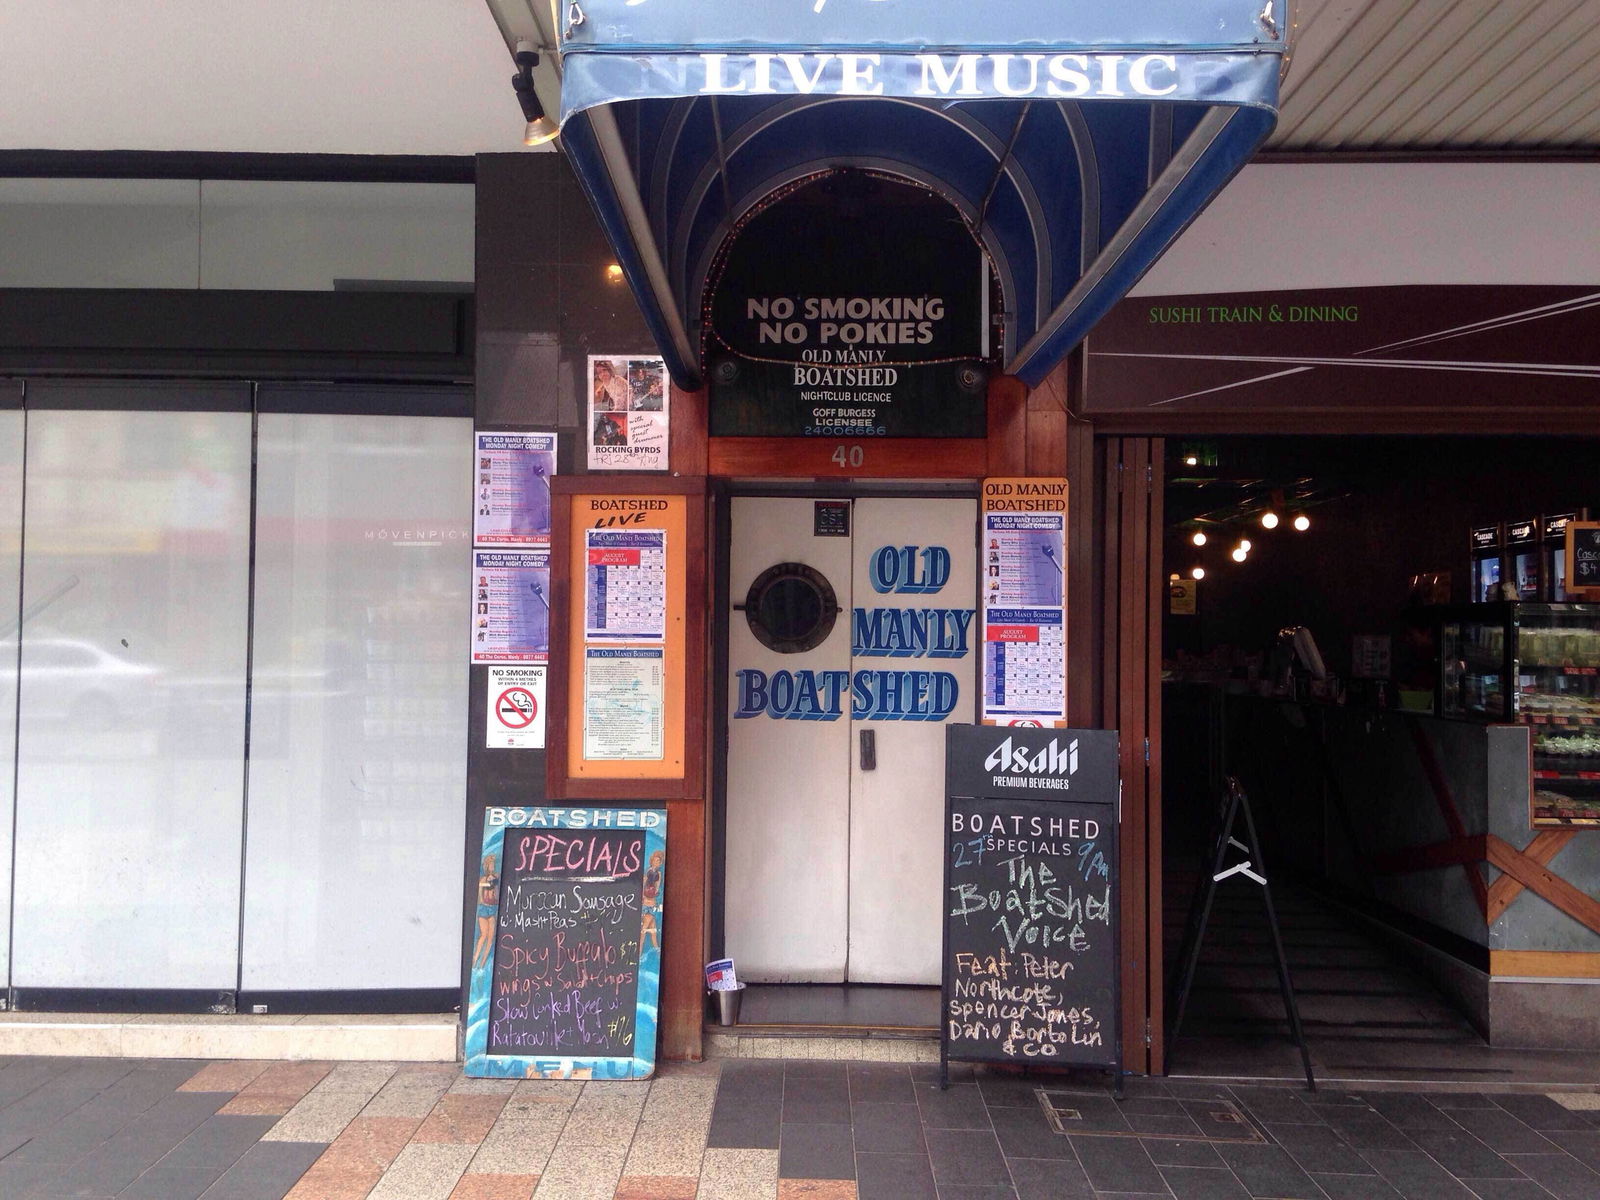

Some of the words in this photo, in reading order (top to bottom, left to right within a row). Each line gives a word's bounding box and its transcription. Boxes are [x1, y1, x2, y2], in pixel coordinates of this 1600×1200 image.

[699, 53, 883, 96] LIVE
[914, 53, 1179, 98] MUSIC
[747, 298, 795, 320] NO
[804, 298, 945, 320] SMOKING
[1149, 307, 1201, 323] SUSHI
[1207, 307, 1262, 322] TRAIN
[1268, 304, 1284, 322] &
[1289, 306, 1358, 322] DINING
[759, 322, 808, 344] NO
[820, 321, 934, 344] POKIES
[802, 350, 831, 363] OLD
[835, 350, 886, 364] MANLY
[793, 367, 898, 386] BOATSHED
[800, 391, 851, 401] NIGHTCLUB
[853, 392, 892, 402] LICENCE
[629, 415, 644, 424] with
[813, 408, 836, 417] GOFF
[838, 408, 876, 418] BURGESS
[631, 419, 653, 433] special
[804, 426, 886, 436] 24006666
[815, 418, 872, 427] LICENSEE
[632, 428, 649, 440] guest
[634, 434, 663, 444] drummer
[595, 446, 633, 454] ROCKING
[634, 446, 661, 454] BYRDS
[831, 445, 864, 468] 40
[985, 483, 1013, 496] OLD
[1016, 483, 1067, 496] MANLY
[590, 499, 668, 511] BOATSHED
[986, 500, 1066, 511] BOATSHED
[594, 512, 647, 529] LIVE
[869, 545, 951, 594] OLD
[852, 608, 976, 658] MANLY
[492, 669, 505, 677] NO
[506, 669, 543, 677] SMOKING
[984, 735, 1079, 775] Asahi
[993, 776, 1027, 788] PREMIUM
[1028, 777, 1069, 790] BEVERAGES
[489, 808, 660, 828] BOATSHED
[951, 813, 1099, 839] BOATSHED
[515, 835, 641, 877] SPECIALS
[986, 838, 1072, 856] SPECIALS
[995, 854, 1057, 889] The
[570, 885, 638, 924] Sausage
[500, 934, 549, 980] Spicy
[553, 928, 617, 980] Buffalo
[1020, 952, 1074, 980] Peter
[494, 997, 529, 1025] Slow
[572, 990, 603, 1028] Beef
